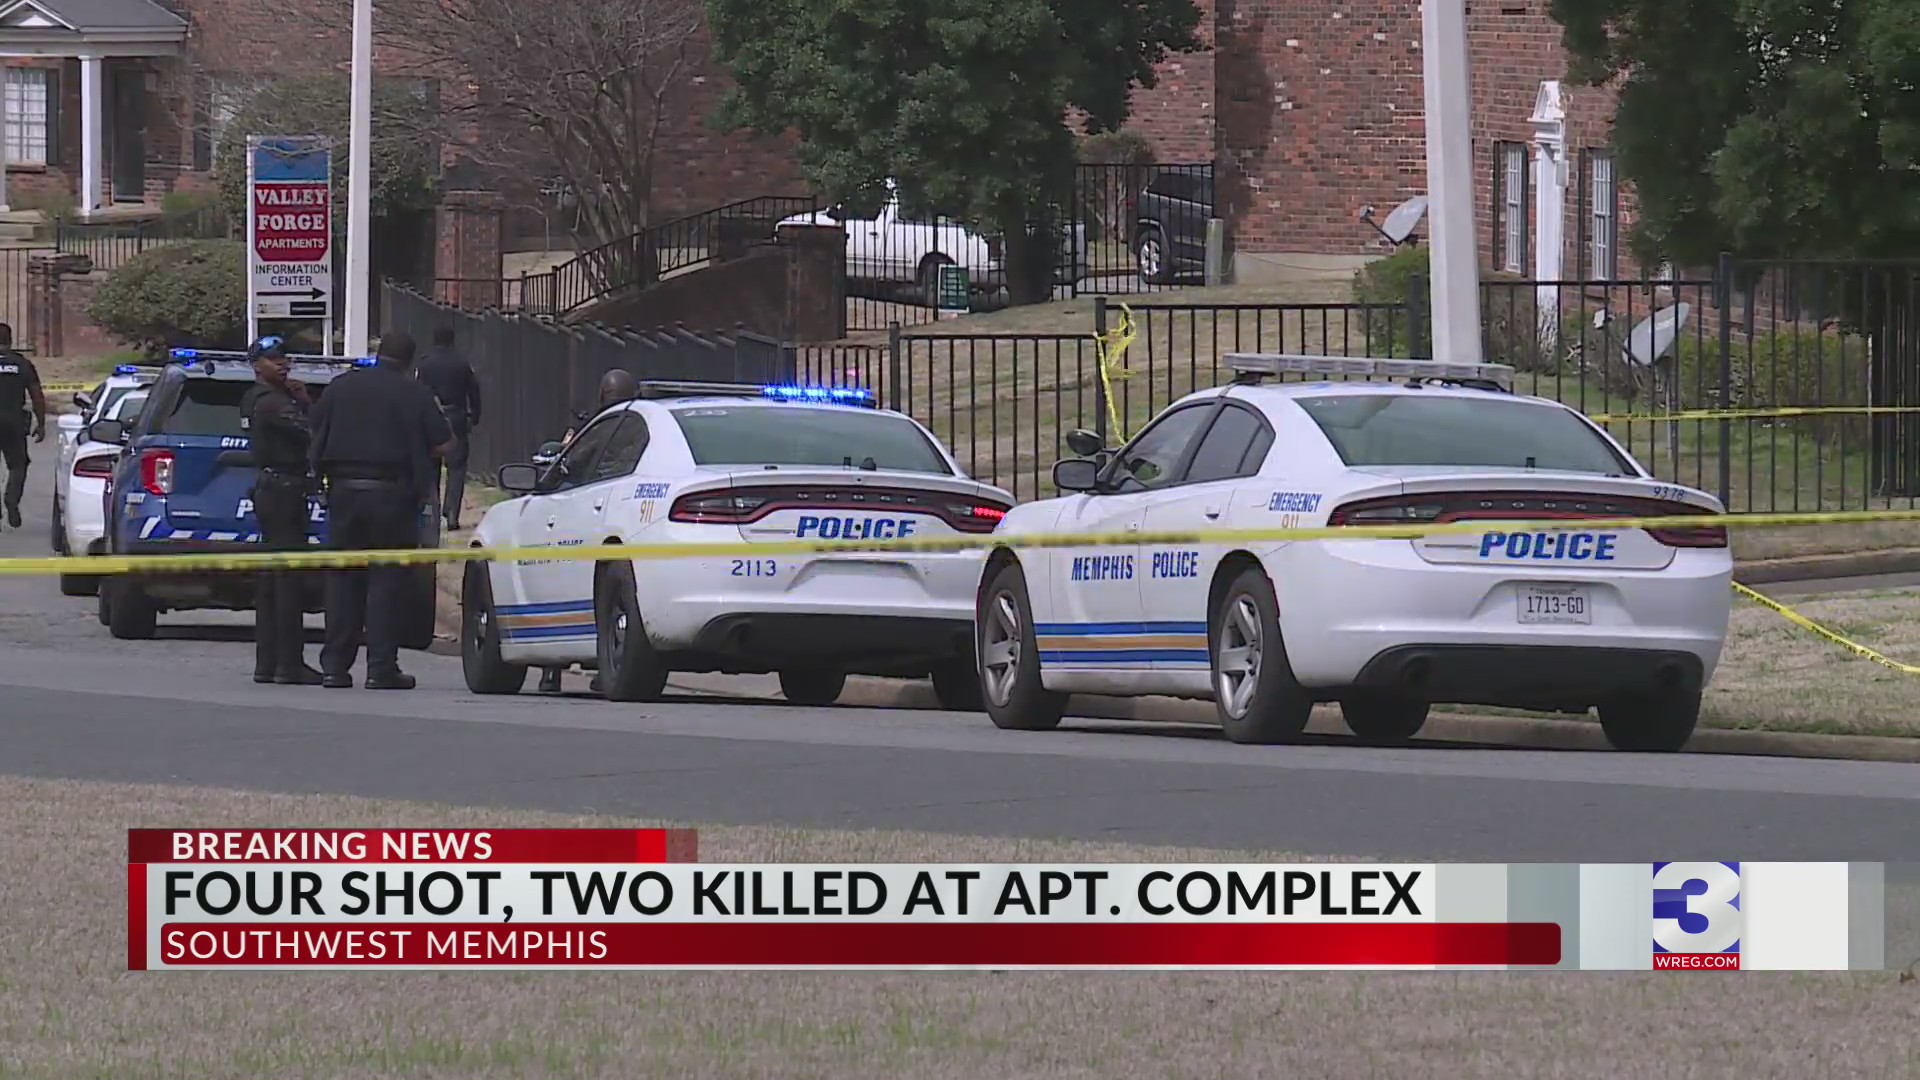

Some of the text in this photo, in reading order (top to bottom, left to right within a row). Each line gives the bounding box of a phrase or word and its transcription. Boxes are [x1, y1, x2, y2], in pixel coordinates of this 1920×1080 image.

[255, 188, 327, 205] VALLEY
[257, 213, 325, 231] FORGE
[258, 238, 325, 249] APARTMENTS
[255, 264, 328, 275] INFORMATION
[270, 275, 312, 286] CENTER
[221, 437, 249, 448] CITY
[634, 483, 671, 499] EMERGENCY
[639, 499, 655, 523] 911
[1269, 491, 1323, 513] EMERGENCY
[796, 515, 917, 540] POLICE
[1479, 530, 1617, 562] POLICE
[731, 559, 777, 577] 2113
[1071, 551, 1199, 581] MEMPHIS POLICE
[1527, 596, 1584, 614] 1713-GD
